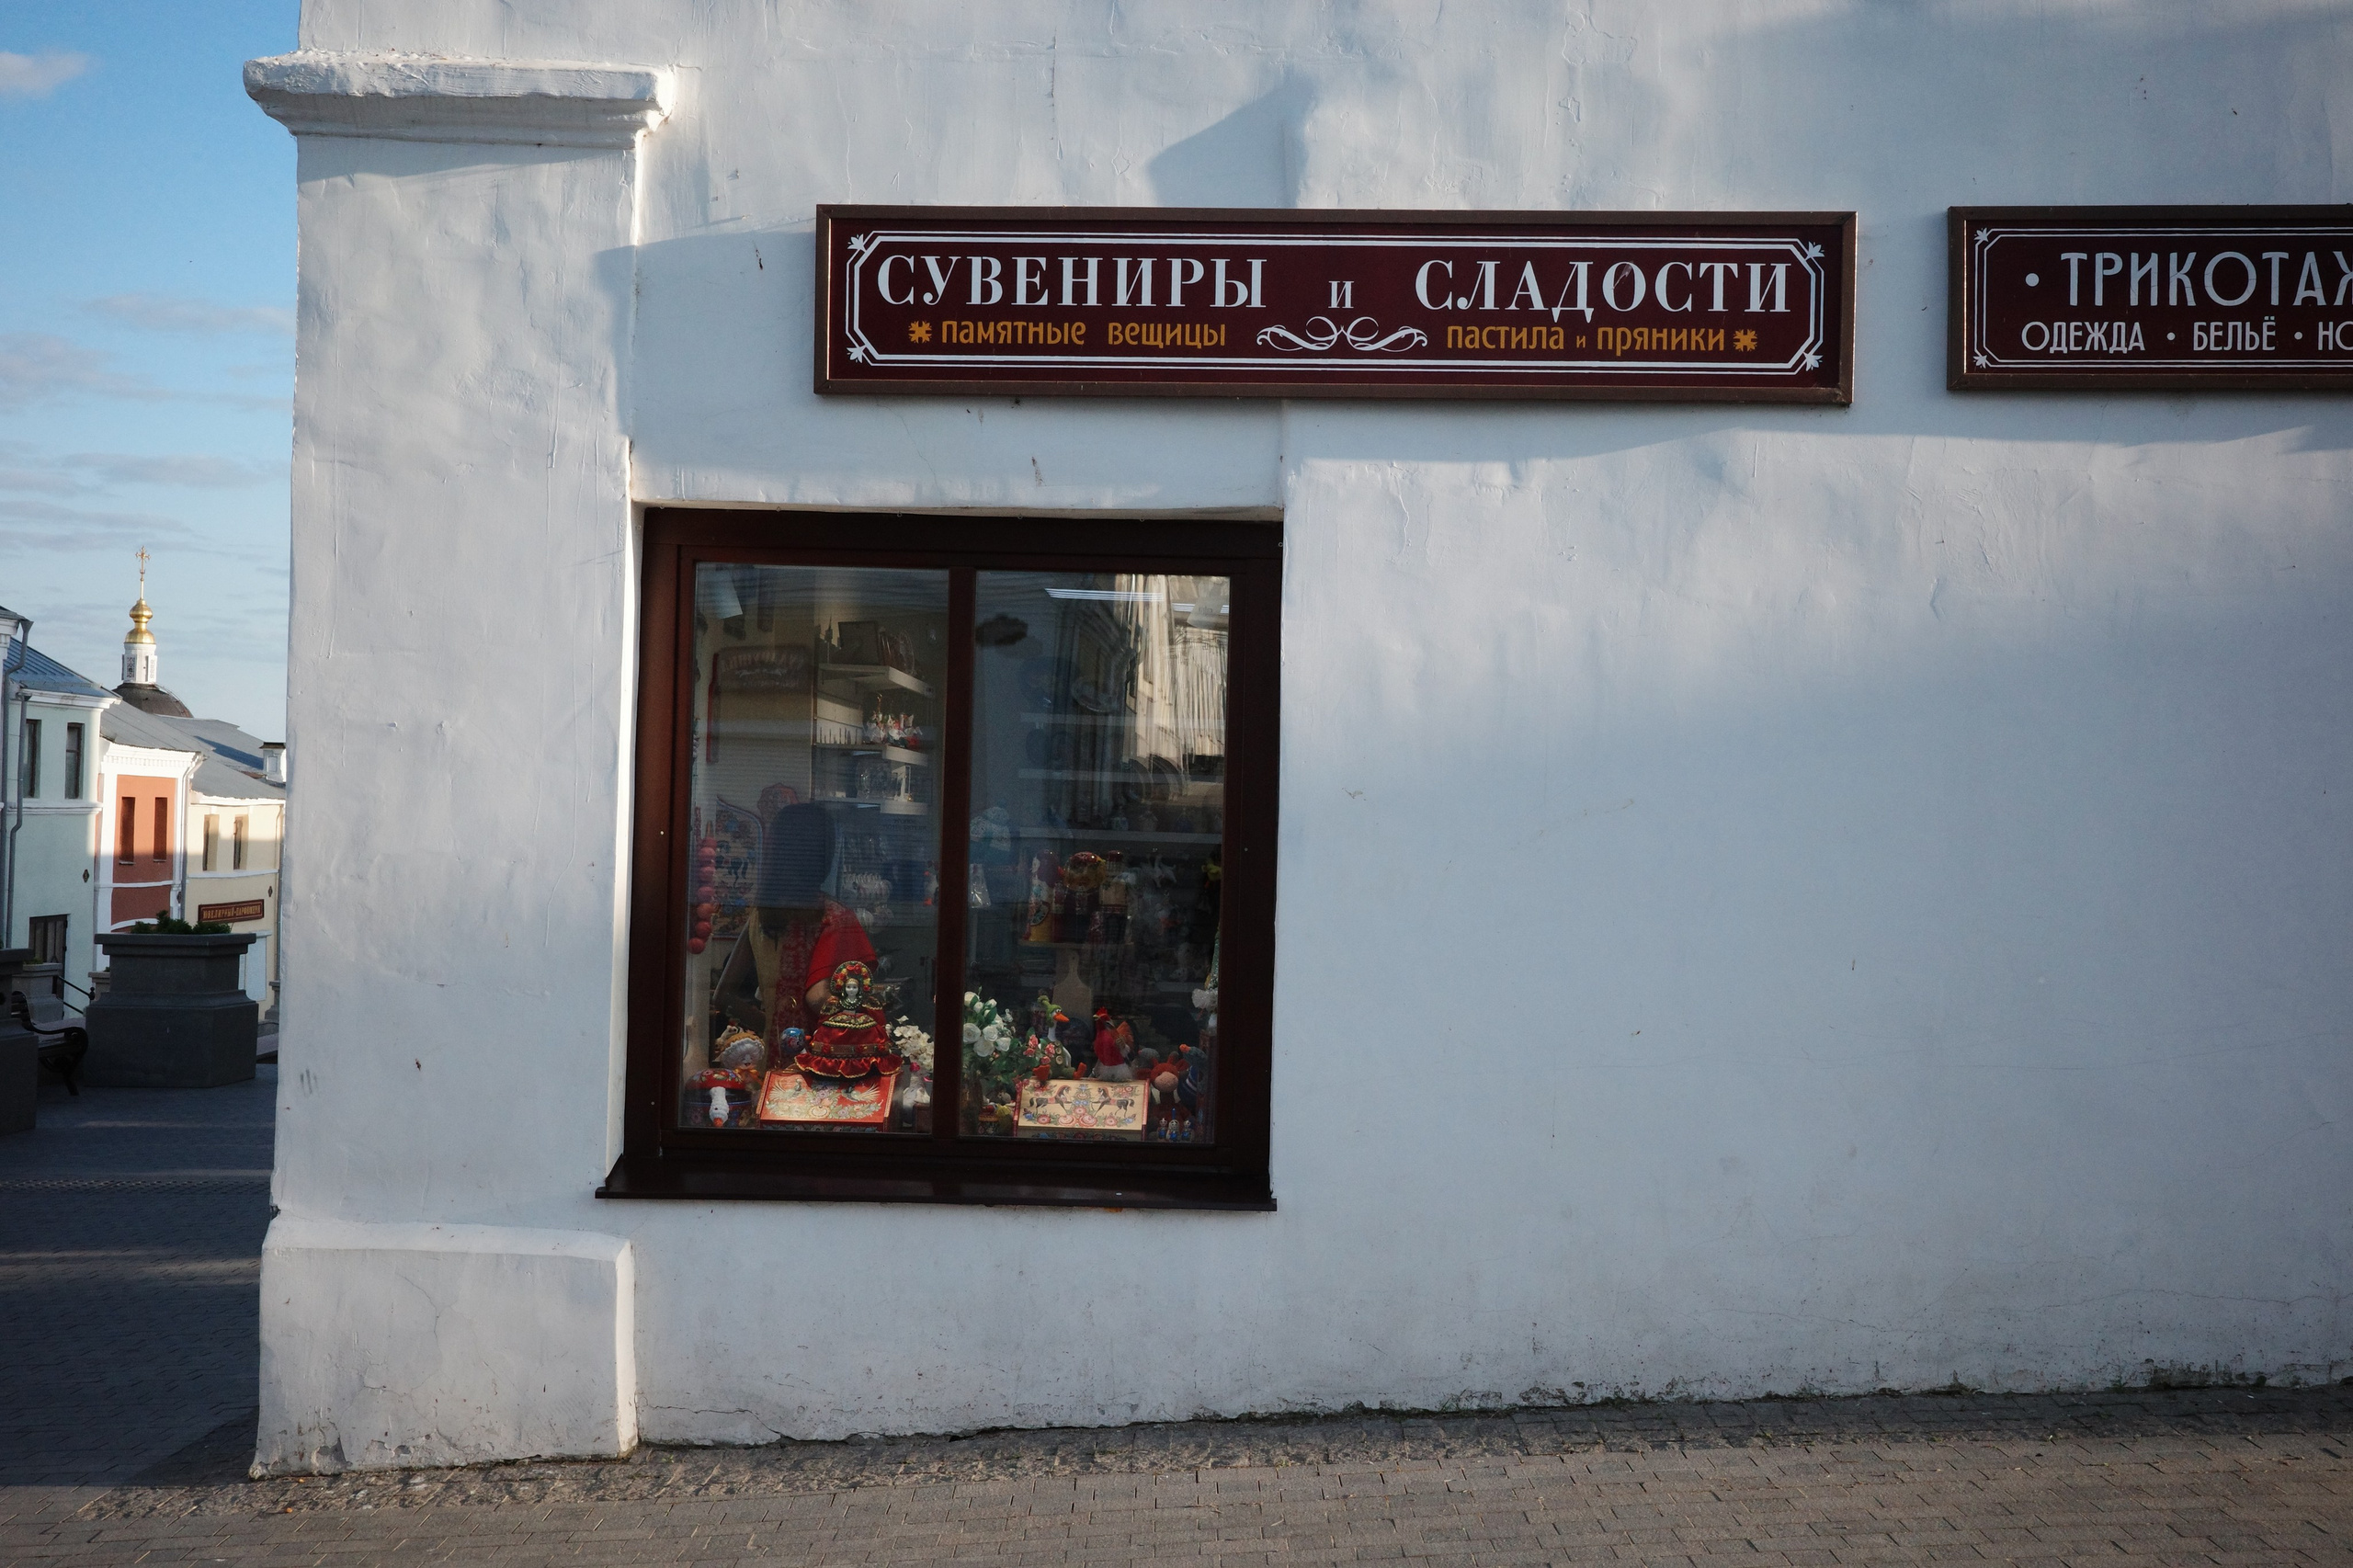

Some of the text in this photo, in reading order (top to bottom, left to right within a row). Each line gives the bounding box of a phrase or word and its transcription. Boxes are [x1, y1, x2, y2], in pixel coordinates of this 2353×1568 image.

[877, 255, 1267, 308] СУВЕНИРЫ
[1415, 259, 1792, 323] СЛАДОСТИ
[941, 320, 1226, 349] памятные вещицы
[1447, 325, 1725, 357] пастила и пряники
[2021, 321, 2145, 354] ОДЕЖДА
[2193, 315, 2276, 351] БЕЛЬЁ
